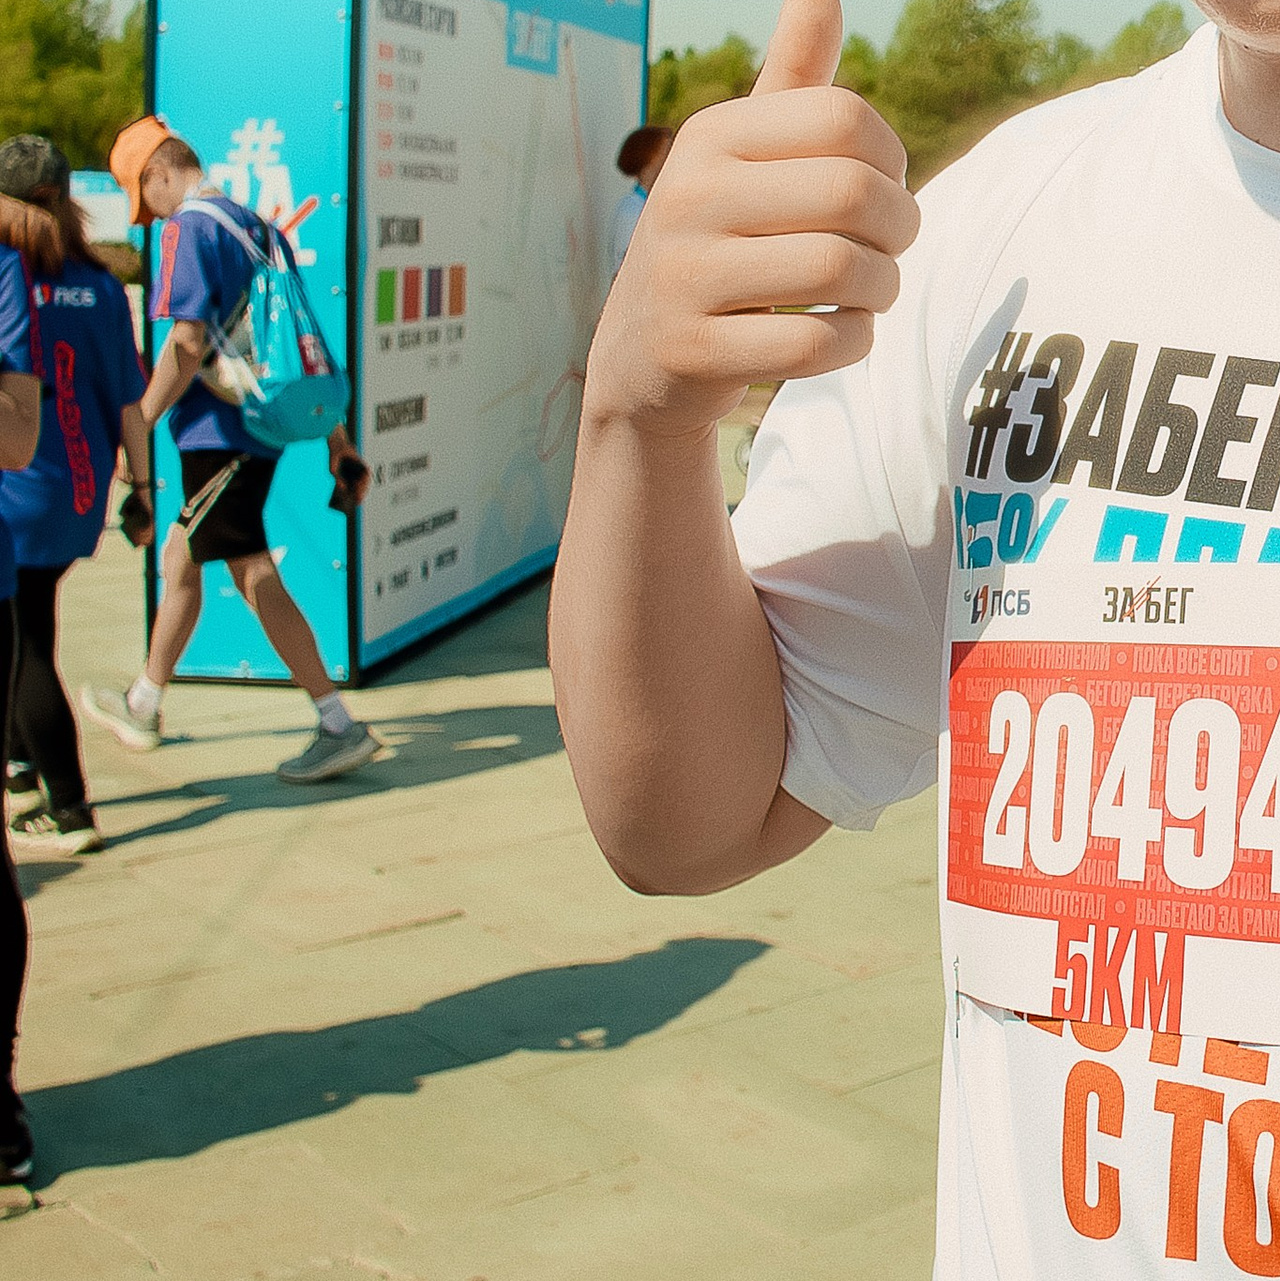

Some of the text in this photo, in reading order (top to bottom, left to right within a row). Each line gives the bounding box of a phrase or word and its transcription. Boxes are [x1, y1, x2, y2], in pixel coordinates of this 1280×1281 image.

[991, 589, 1031, 617] ПСБ
[1133, 646, 1174, 674] ПОКА
[1176, 647, 1208, 676] ВСЕ
[1209, 649, 1253, 678] СПЯТ
[1010, 884, 1050, 914] ДАВНО
[1052, 889, 1106, 920] ОТСТАЛ
[1136, 898, 1216, 932] ВЫБЕГАЮ
[1218, 906, 1240, 935] ЗА
[1063, 1060, 1124, 1240] С
